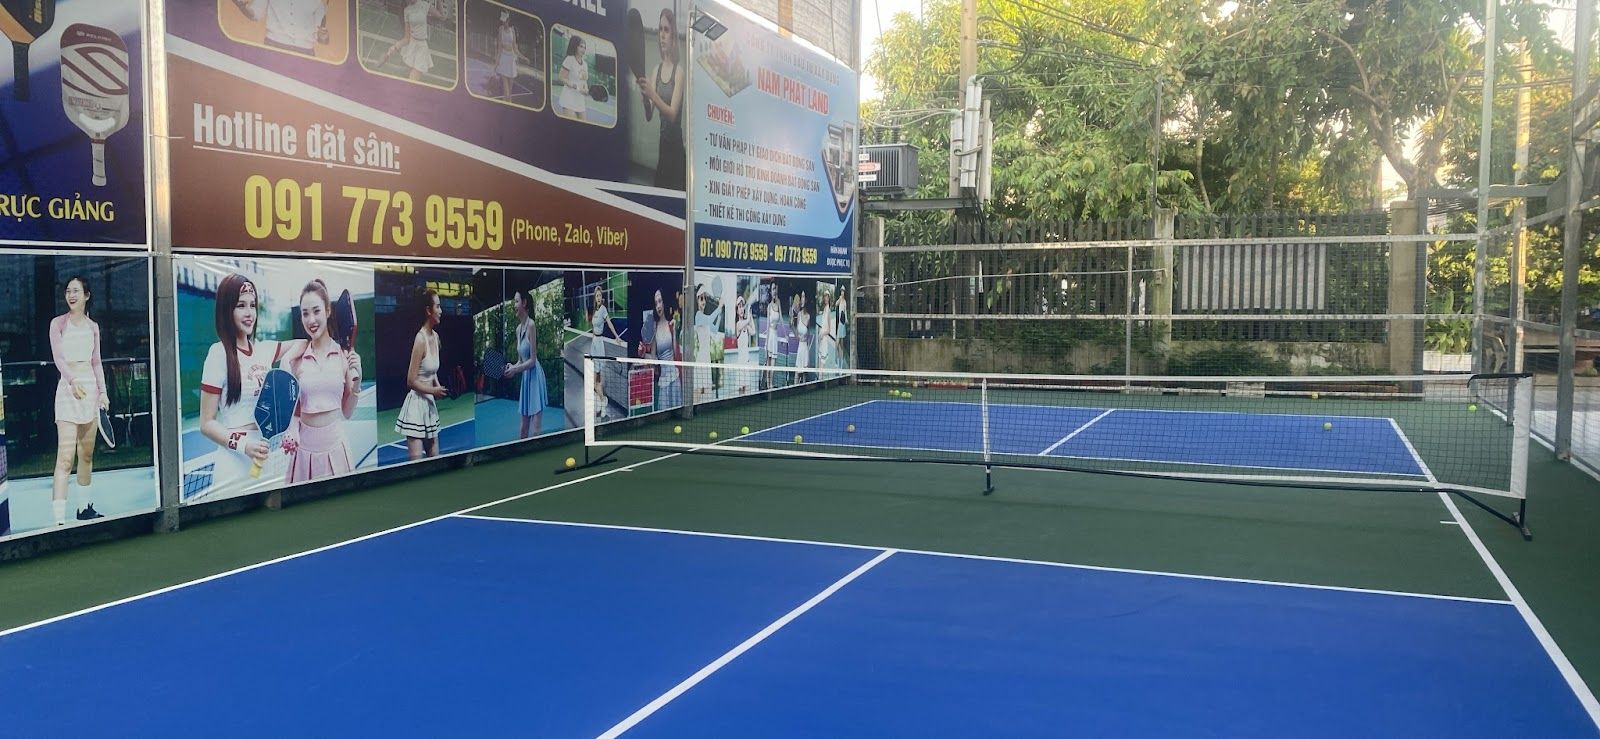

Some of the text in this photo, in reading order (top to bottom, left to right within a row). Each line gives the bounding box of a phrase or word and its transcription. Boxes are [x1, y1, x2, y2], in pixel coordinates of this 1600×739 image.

[757, 66, 780, 97] NAM
[808, 87, 829, 114] LAND
[193, 102, 400, 170] Hotline đặt sân:
[709, 179, 720, 195] XIN
[48, 192, 114, 222] GIẢNG
[244, 174, 629, 251] 091 773 9559 (Phone, Zalo, Viber)
[736, 207, 745, 221] THI
[715, 239, 732, 260] 090
[733, 241, 748, 260] 773
[749, 242, 768, 262] 9559
[774, 244, 787, 263] 097
[788, 245, 801, 263] 773
[801, 247, 817, 265] 9559
